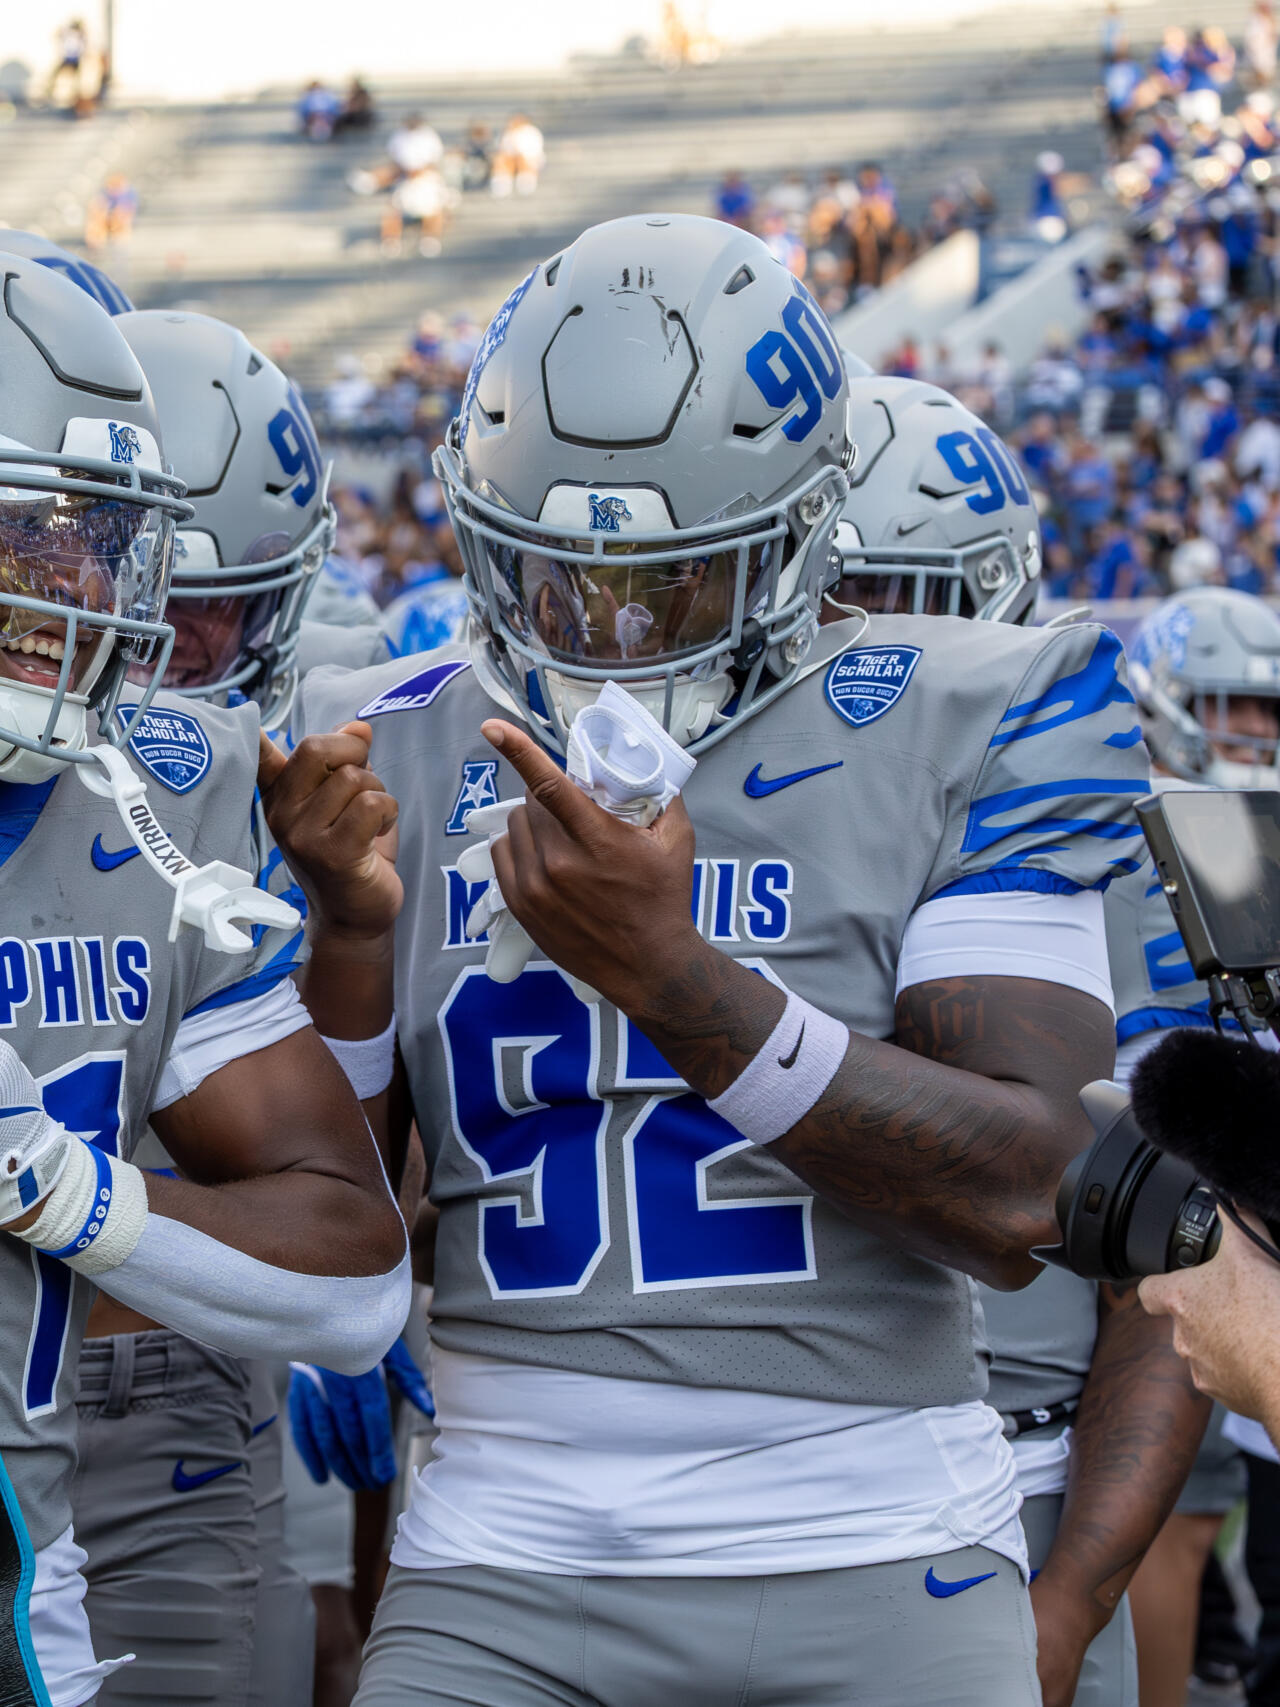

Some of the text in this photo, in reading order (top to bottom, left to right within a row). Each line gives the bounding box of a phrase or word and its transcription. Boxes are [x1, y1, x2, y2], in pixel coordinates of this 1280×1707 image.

[854, 654, 900, 666] TIGER
[837, 665, 904, 678] SCHOLAR
[143, 714, 185, 731] TIGER
[134, 726, 200, 745] SCHOLAR
[129, 804, 192, 876] NXTRND
[436, 957, 818, 1300] 92
